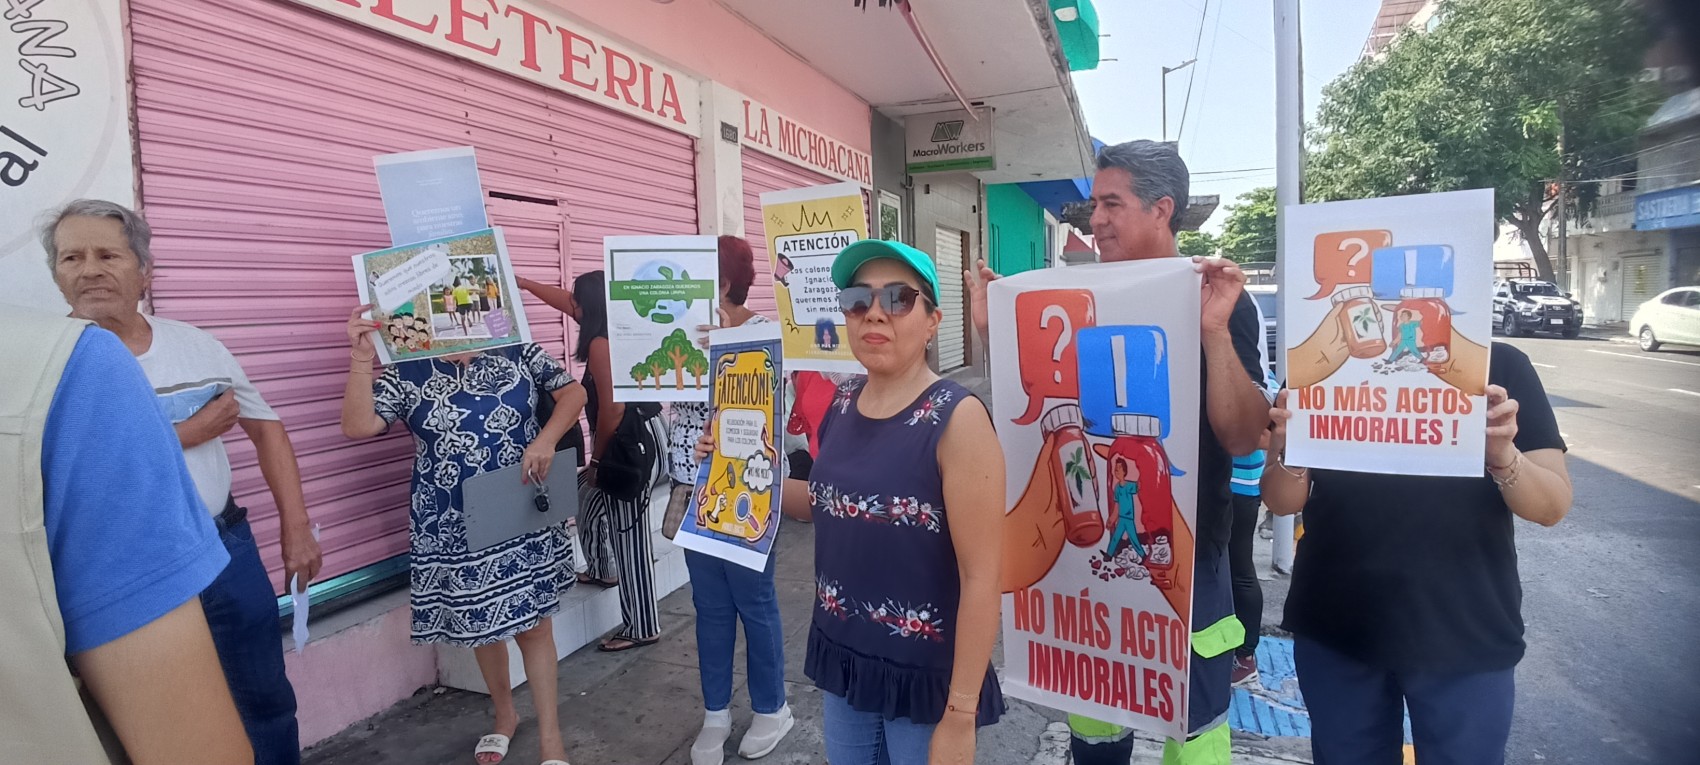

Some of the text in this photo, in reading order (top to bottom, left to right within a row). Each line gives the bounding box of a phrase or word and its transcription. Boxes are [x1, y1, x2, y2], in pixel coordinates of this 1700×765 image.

[330, 0, 687, 125] LETERIA
[742, 99, 872, 186] LA MICHOACANA
[913, 142, 985, 158] MacroWorkers
[783, 233, 849, 253] ATENCIÓN
[805, 265, 832, 274] colono
[805, 276, 834, 285] Ignacio
[795, 296, 831, 304] queremos
[803, 286, 838, 294] Zaragoza
[1298, 380, 1473, 415] NO MÁS ACTOS
[1309, 414, 1459, 446] INMORALES !
[1013, 587, 1187, 676] NO MÁS ACTO
[1028, 640, 1174, 723] INMORALES
